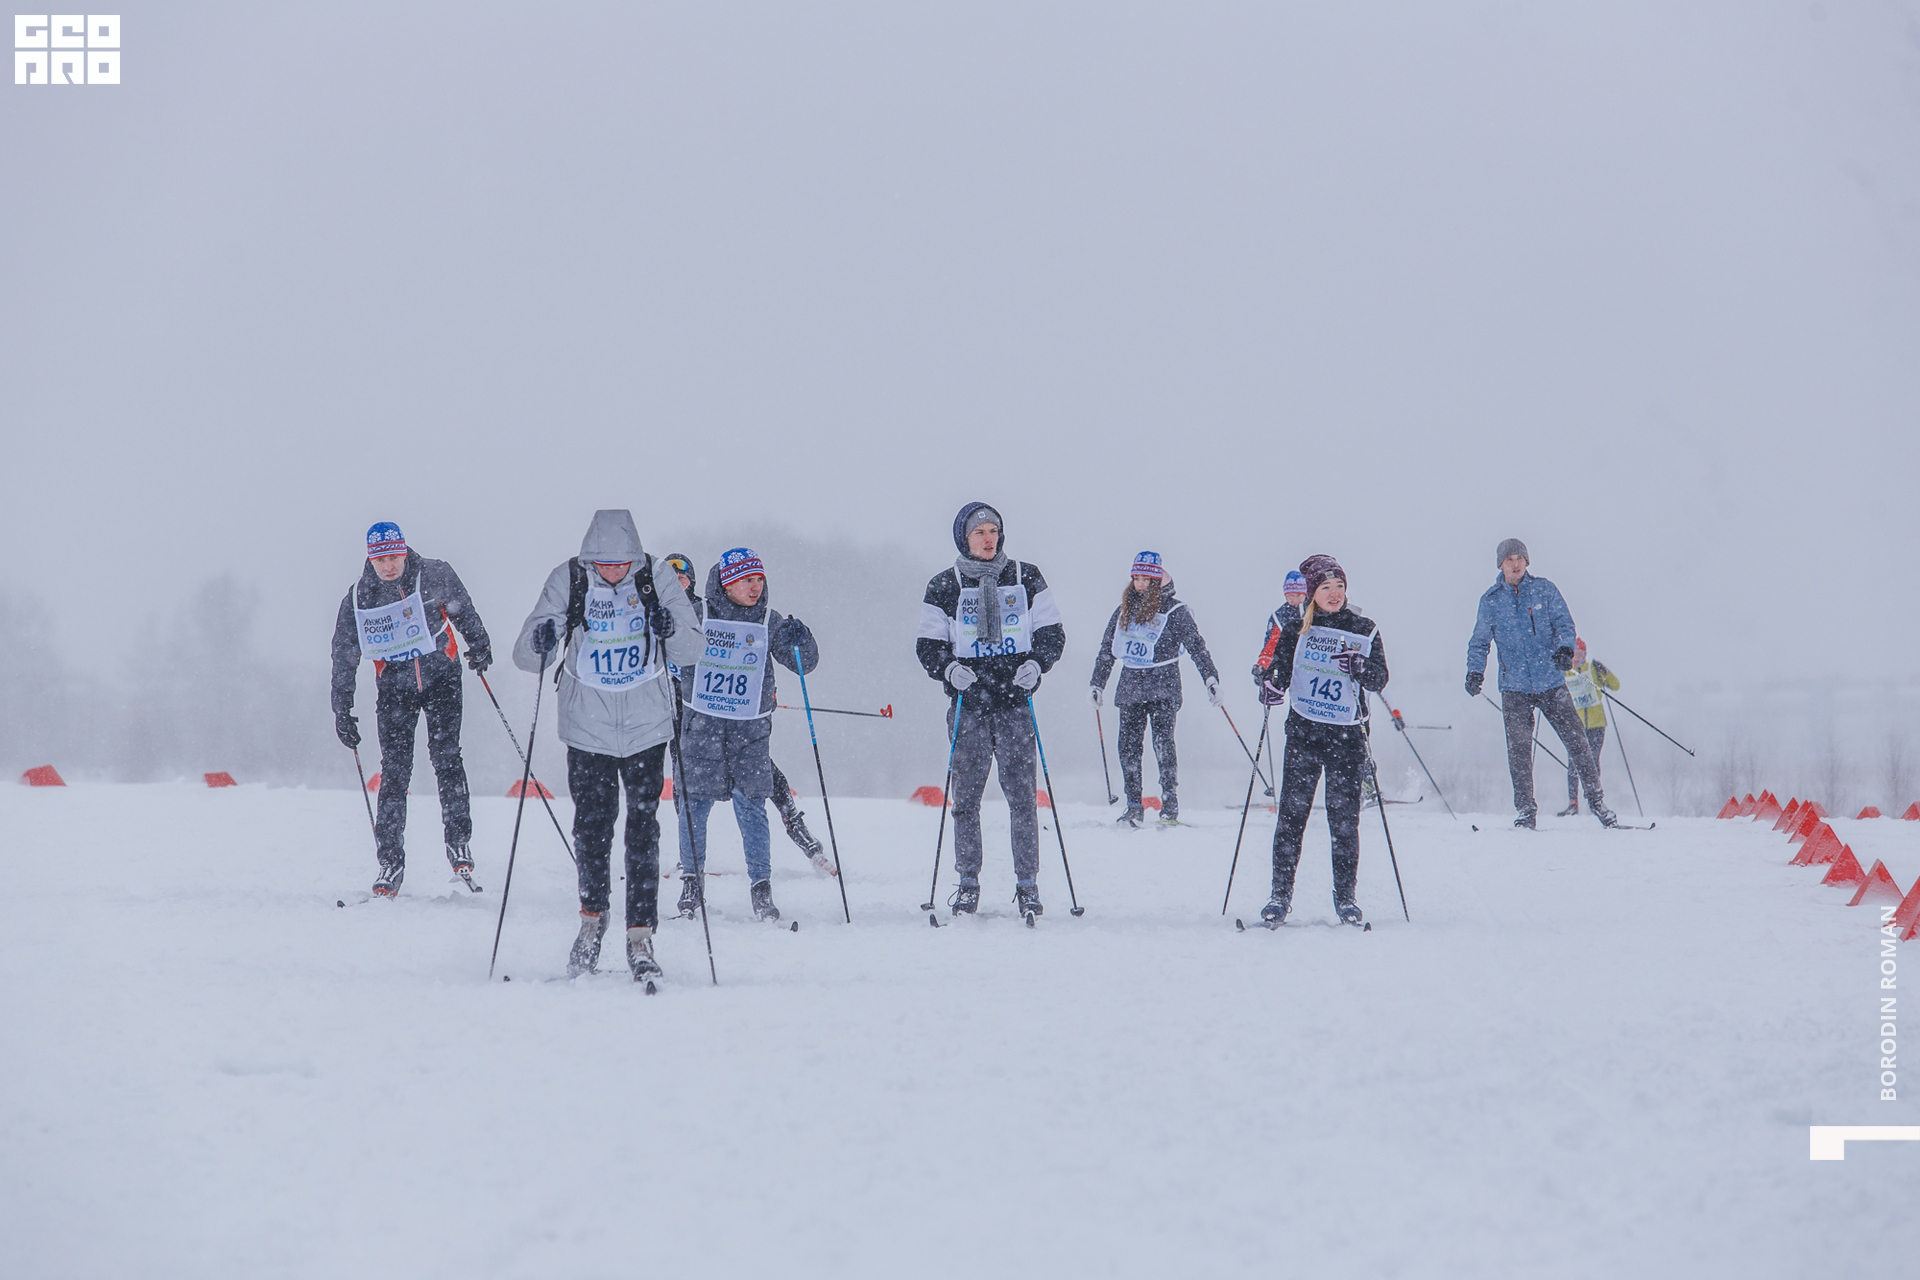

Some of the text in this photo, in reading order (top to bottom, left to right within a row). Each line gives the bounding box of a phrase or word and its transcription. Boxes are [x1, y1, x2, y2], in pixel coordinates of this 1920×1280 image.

[364, 623, 395, 634] РОССИИ
[366, 632, 394, 645] 2021
[1306, 635, 1339, 646] ЛЫЖНЯ
[1125, 640, 1148, 657] 130
[1305, 641, 1337, 654] РОССИИ
[590, 645, 640, 673] 1178
[600, 675, 635, 686] ОБЛАСТЬ
[704, 671, 748, 697] 1218
[1309, 676, 1343, 702] 143
[696, 692, 751, 706] НИЖЕГОРОДСКАЯ
[1297, 696, 1351, 714] НИЖЕГОРОДСКАЯ
[707, 702, 737, 713] ОБЛАСТЬ
[1307, 706, 1337, 719] ОБЛАСТЬ
